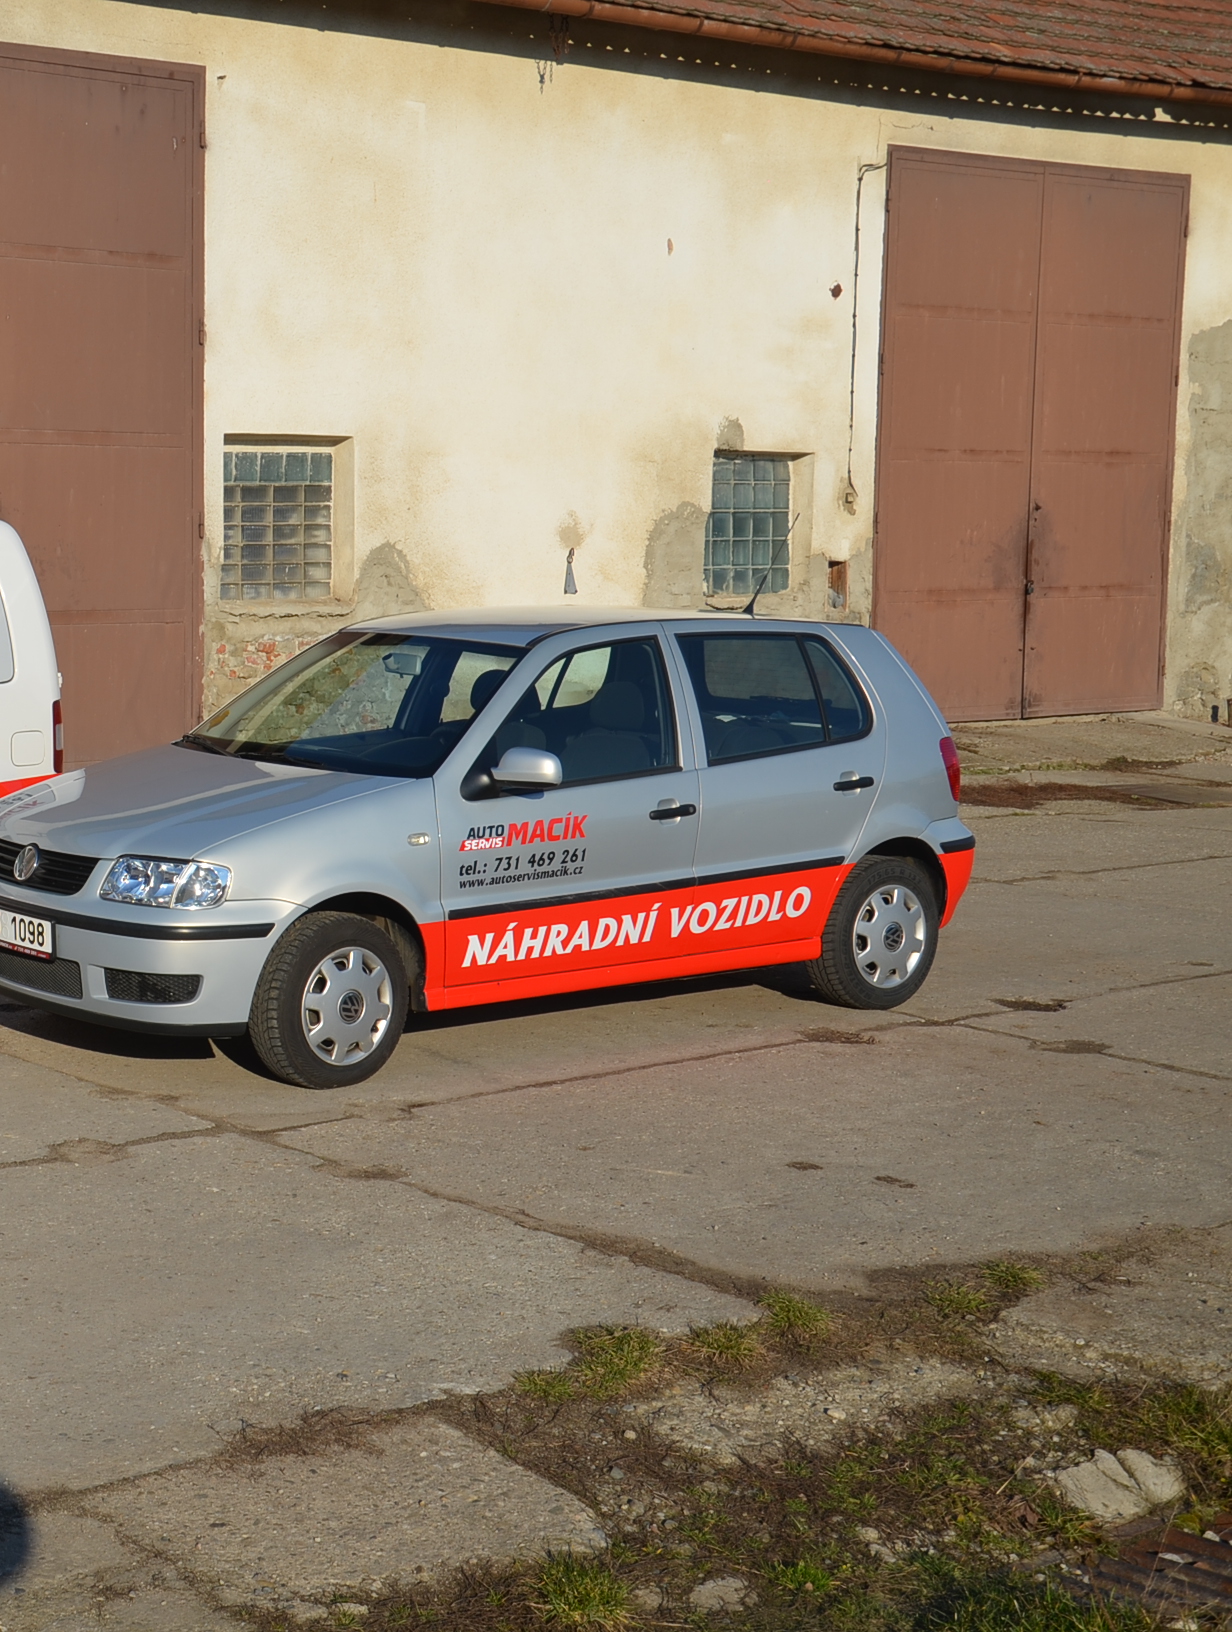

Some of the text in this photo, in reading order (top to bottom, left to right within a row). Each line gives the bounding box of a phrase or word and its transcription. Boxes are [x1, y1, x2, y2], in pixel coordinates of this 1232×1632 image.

[467, 824, 505, 839] AUTO
[506, 811, 588, 847] MACÍK
[464, 837, 503, 851] SERVIS
[459, 848, 587, 876] tel.: 731 469 261
[459, 865, 584, 889] www.autoservismacik.cz
[11, 916, 45, 947] 1098
[461, 886, 812, 968] NÁHRADNÍ VOZIDLO
